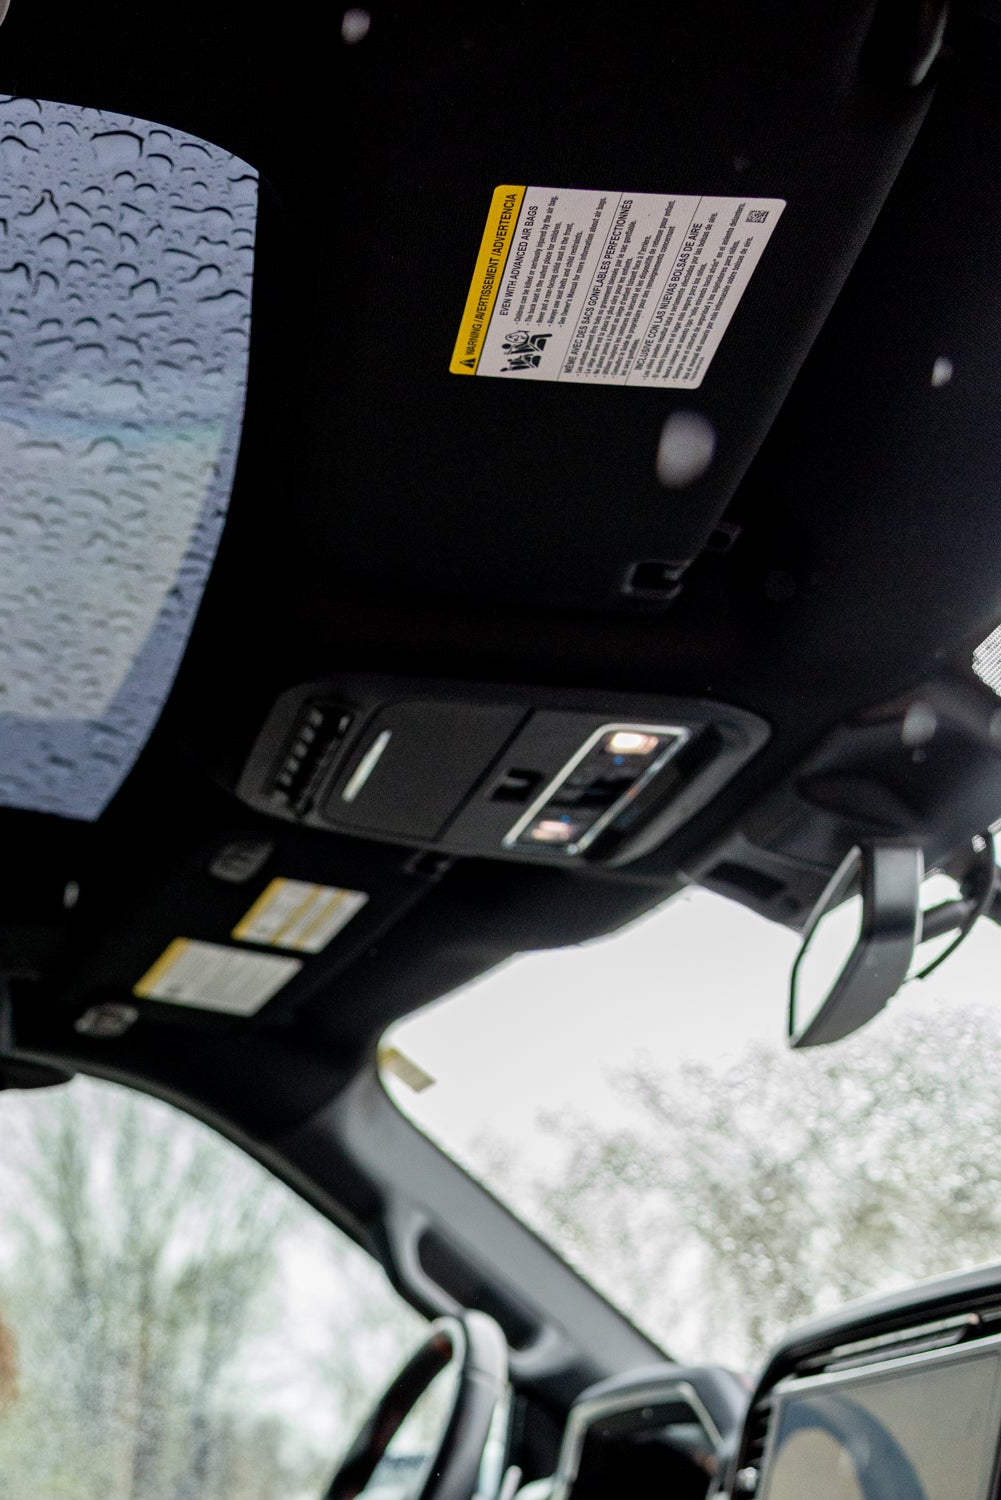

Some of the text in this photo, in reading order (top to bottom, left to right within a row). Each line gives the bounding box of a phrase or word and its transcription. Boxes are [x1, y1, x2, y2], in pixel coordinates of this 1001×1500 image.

[499, 205, 538, 315] EVEN WITH ADVANCED AIR BAGS
[586, 260, 611, 306] GONFLABLES
[633, 222, 703, 370] INCLUSIVE CON LAS NUEVAS BOLSAS DE AIRE
[580, 306, 595, 324] SACS
[465, 323, 482, 355] WARNING
[569, 338, 583, 355] AVEC
[575, 325, 588, 338] DES
